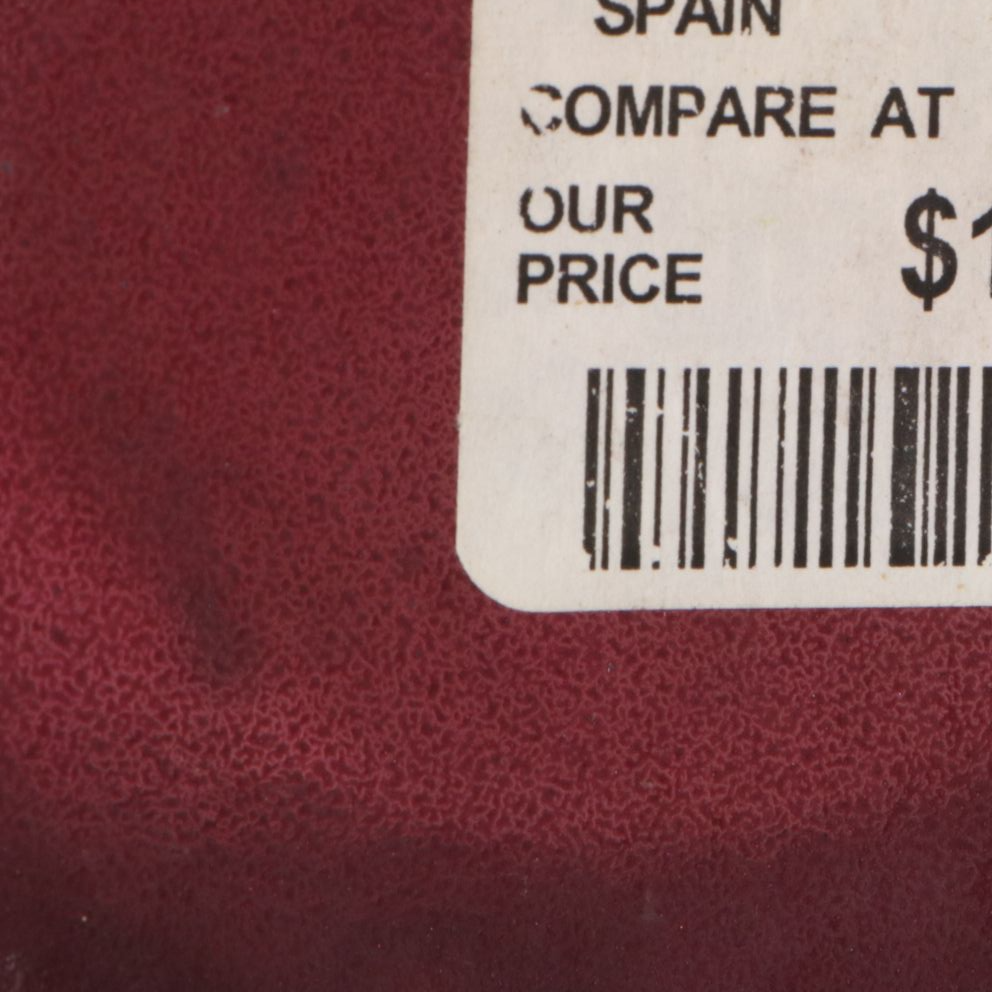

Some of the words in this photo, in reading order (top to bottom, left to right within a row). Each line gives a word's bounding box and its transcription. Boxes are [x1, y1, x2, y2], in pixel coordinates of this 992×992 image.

[521, 85, 838, 138] COMPARE
[871, 87, 956, 139] AT
[520, 185, 655, 234] OUR
[517, 254, 704, 305] PRICE
